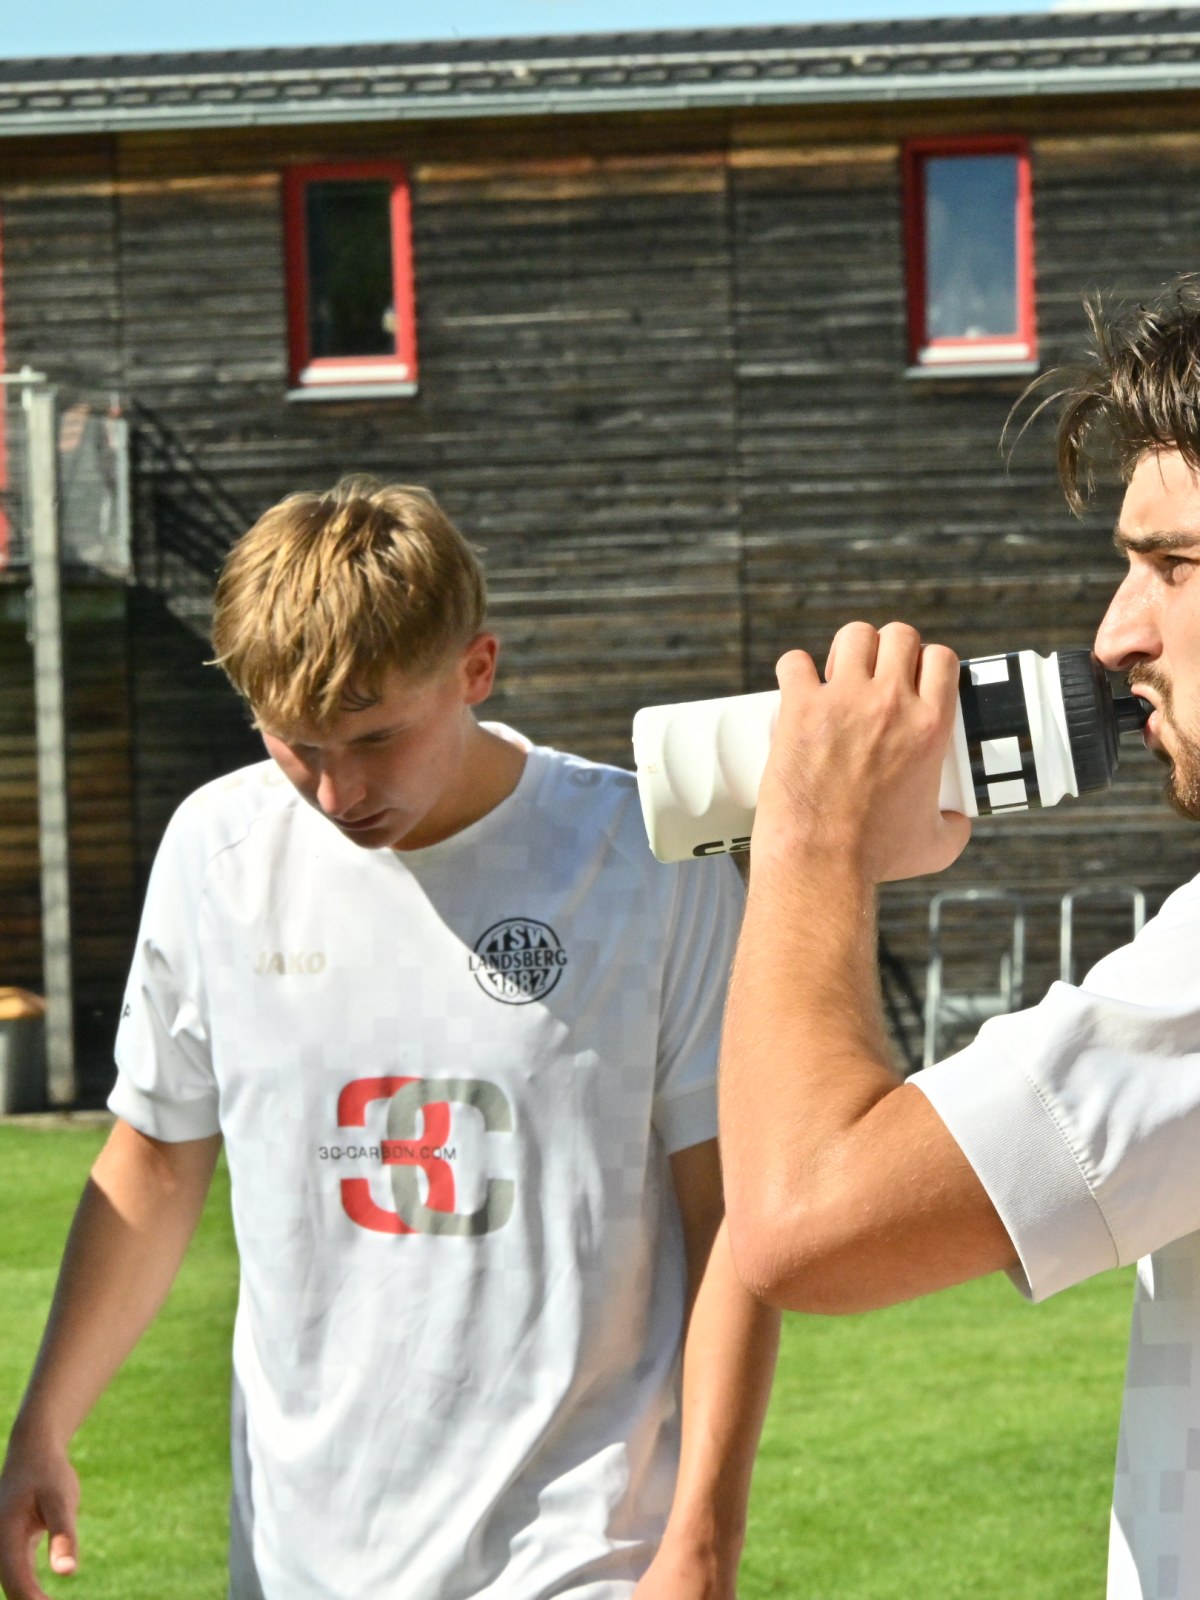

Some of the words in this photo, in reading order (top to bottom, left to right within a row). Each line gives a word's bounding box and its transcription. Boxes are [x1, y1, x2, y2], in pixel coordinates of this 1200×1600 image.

[490, 925, 544, 951] TSV
[253, 952, 328, 976] JAKO
[468, 948, 568, 972] LANDSBERG
[492, 969, 546, 997] 1882
[319, 1145, 457, 1161] 3C-CARBON.COM
